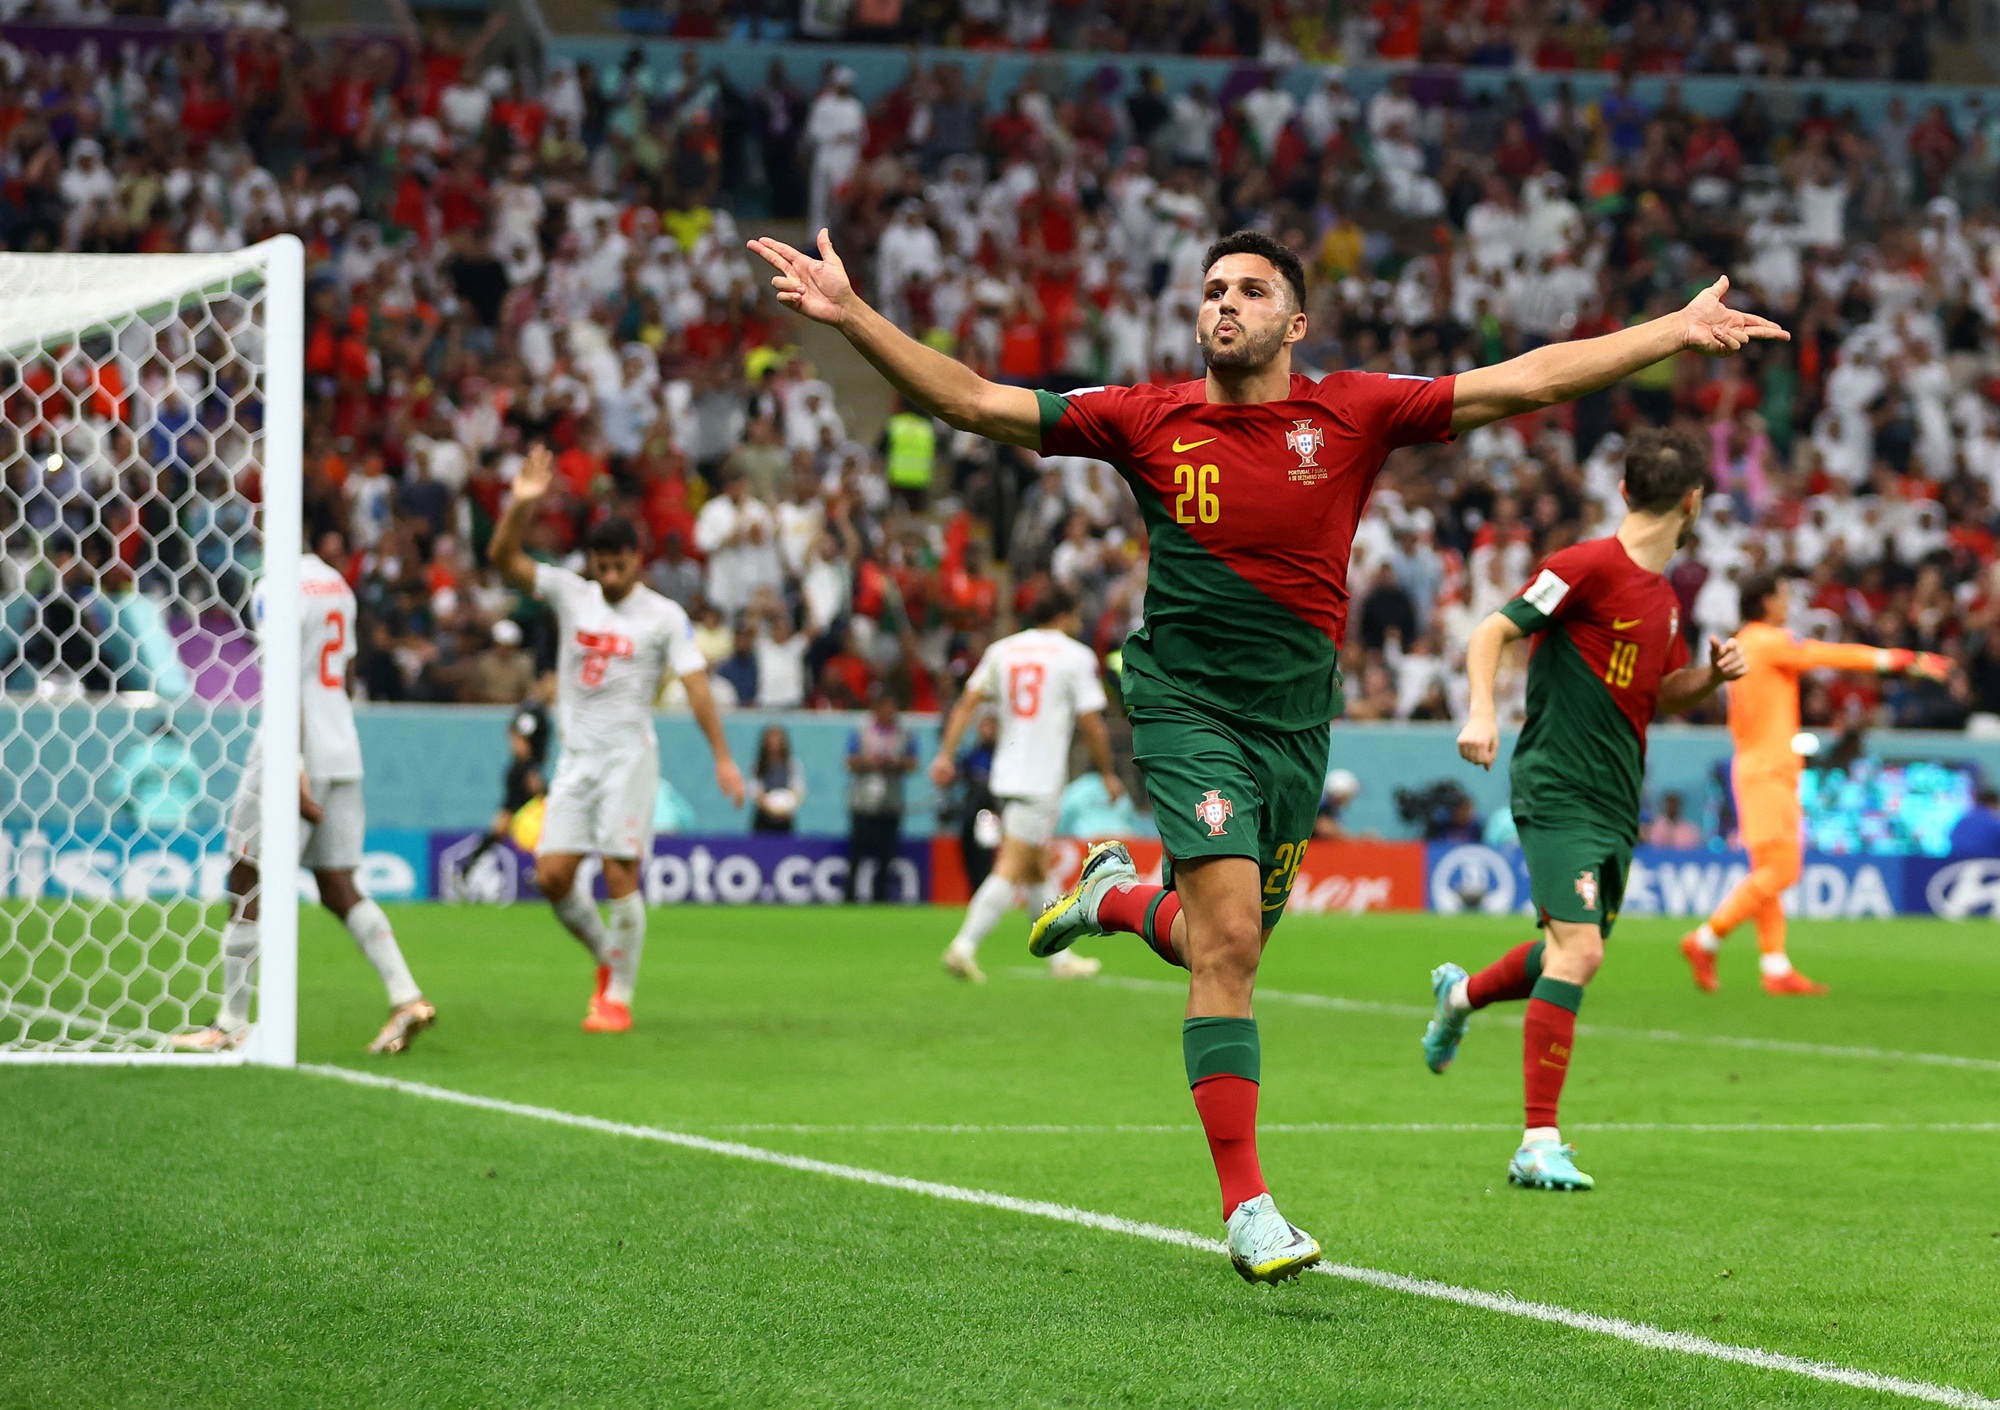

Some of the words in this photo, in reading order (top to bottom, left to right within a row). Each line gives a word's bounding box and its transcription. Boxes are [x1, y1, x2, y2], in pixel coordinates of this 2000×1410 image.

[1174, 464, 1220, 524] 26
[319, 610, 346, 687] 2
[1605, 639, 1640, 690] 10
[1009, 663, 1045, 718] 13
[1263, 839, 1309, 894] 26
